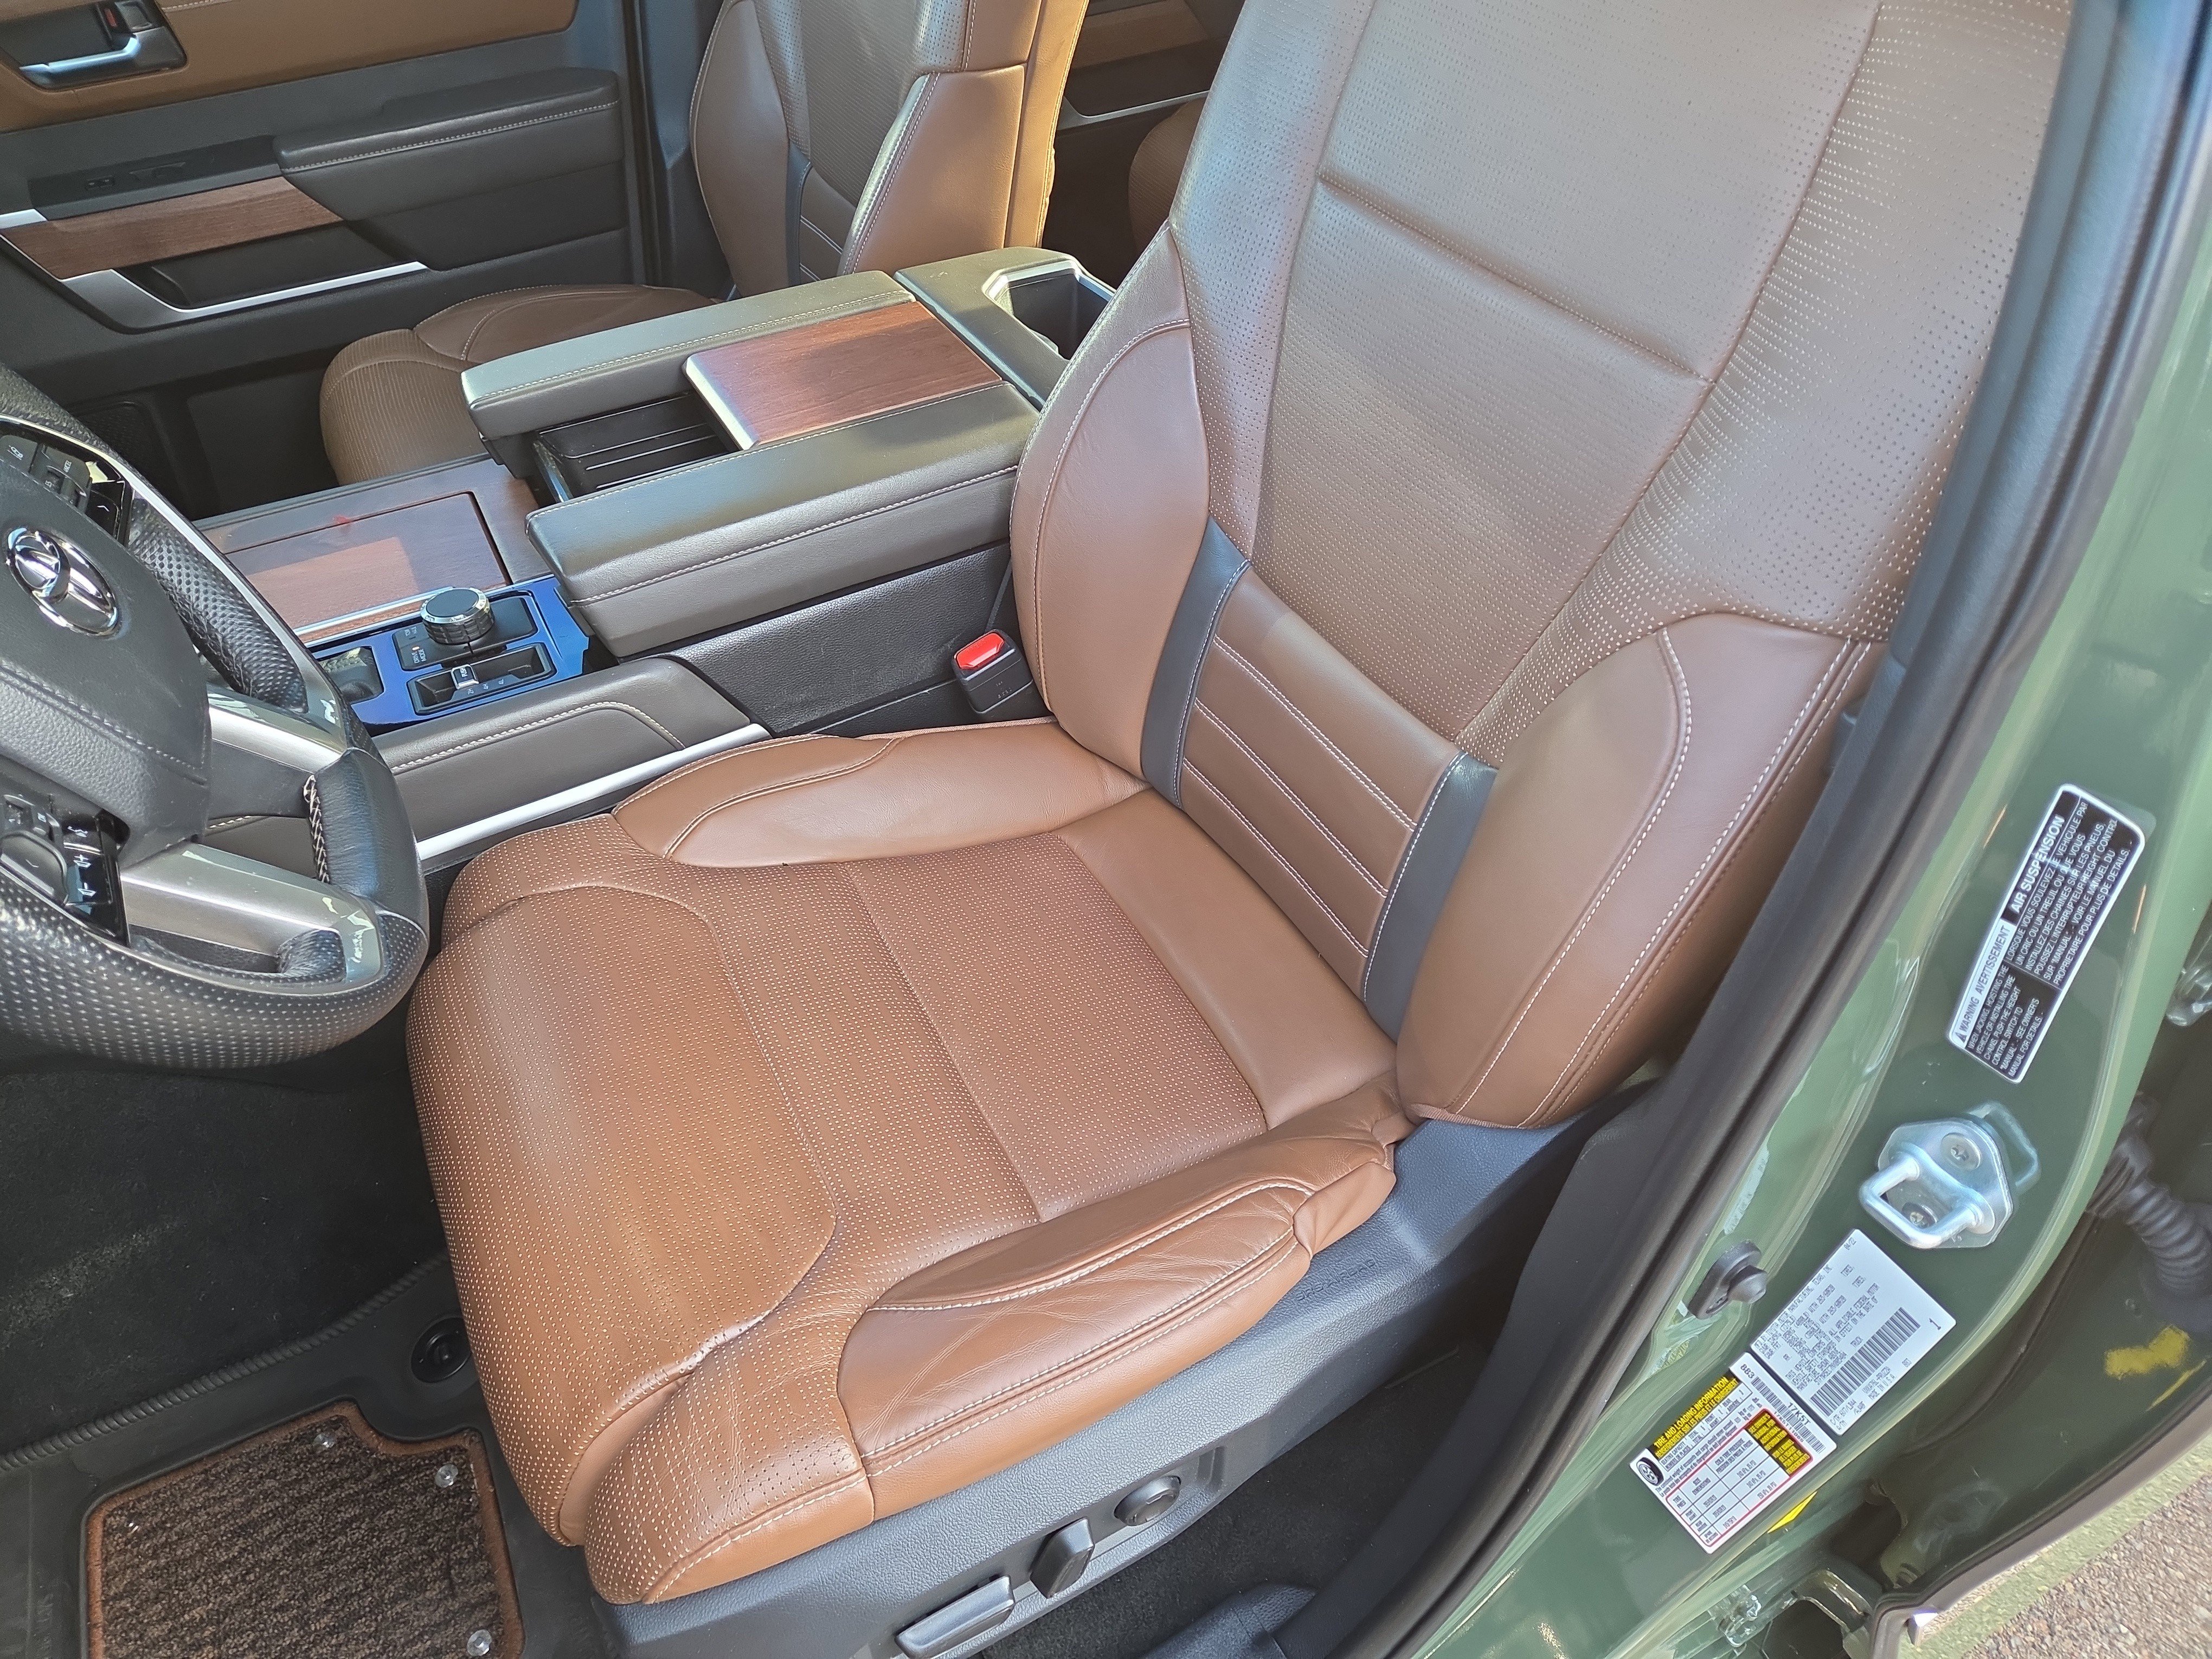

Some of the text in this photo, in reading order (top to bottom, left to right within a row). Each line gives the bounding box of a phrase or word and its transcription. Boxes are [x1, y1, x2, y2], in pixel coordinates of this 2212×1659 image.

[2005, 927, 2027, 961] LORSQUE
[2021, 906, 2036, 929] VOUS
[2031, 866, 2056, 909] SOULEVEZ
[2056, 815, 2081, 858] VEHICULE
[2075, 801, 2089, 818] PAR
[2010, 813, 2066, 914] AIR SUSPENSION
[2015, 832, 2086, 966] UN CRIC OU UN TREUIL OU QUE VOUS
[2024, 933, 2048, 971] INSTALLEZ
[2042, 918, 2056, 936] DES
[2050, 884, 2073, 921] CHAINES
[2067, 867, 2081, 887] SUR
[2075, 851, 2089, 870] LES
[2033, 941, 2055, 976] POUSSEZ
[2080, 852, 2101, 884] HEIGHT
[2043, 848, 2115, 981] SUR VOIR LE MANUEL DU
[2053, 935, 2084, 986] PROPRIETAIRE
[2078, 913, 2095, 937] POUR
[2089, 892, 2106, 916] PLUS
[2100, 880, 2113, 896] DE
[1958, 924, 2010, 1033] WARNING AVERTISSEMENT
[1985, 977, 2003, 1008] HOISTING
[1998, 963, 2009, 979] THE
[2005, 985, 2022, 1011] HEIGHT
[1975, 973, 2016, 1055] VEHICLE OR INSTALLING TIRE
[1991, 1005, 2023, 1066] CONTROL SWITCH TO
[1993, 1020, 2005, 1038] PUSH
[2000, 1008, 2011, 1022] THE
[2015, 1025, 2026, 1040] SEE
[2007, 1051, 2025, 1077] MANUAL
[2019, 1039, 2031, 1054] FOR
[1765, 1321, 1779, 1336] TOYOTA
[1790, 1369, 1807, 1386] VEHICLE
[1793, 1355, 1810, 1372] VEHICLE
[1867, 1388, 1880, 1400] MADE
[1652, 1434, 1668, 1449] TIRE
[1673, 1406, 1697, 1430] LOADING
[1693, 1375, 1729, 1411] INFORMATION
